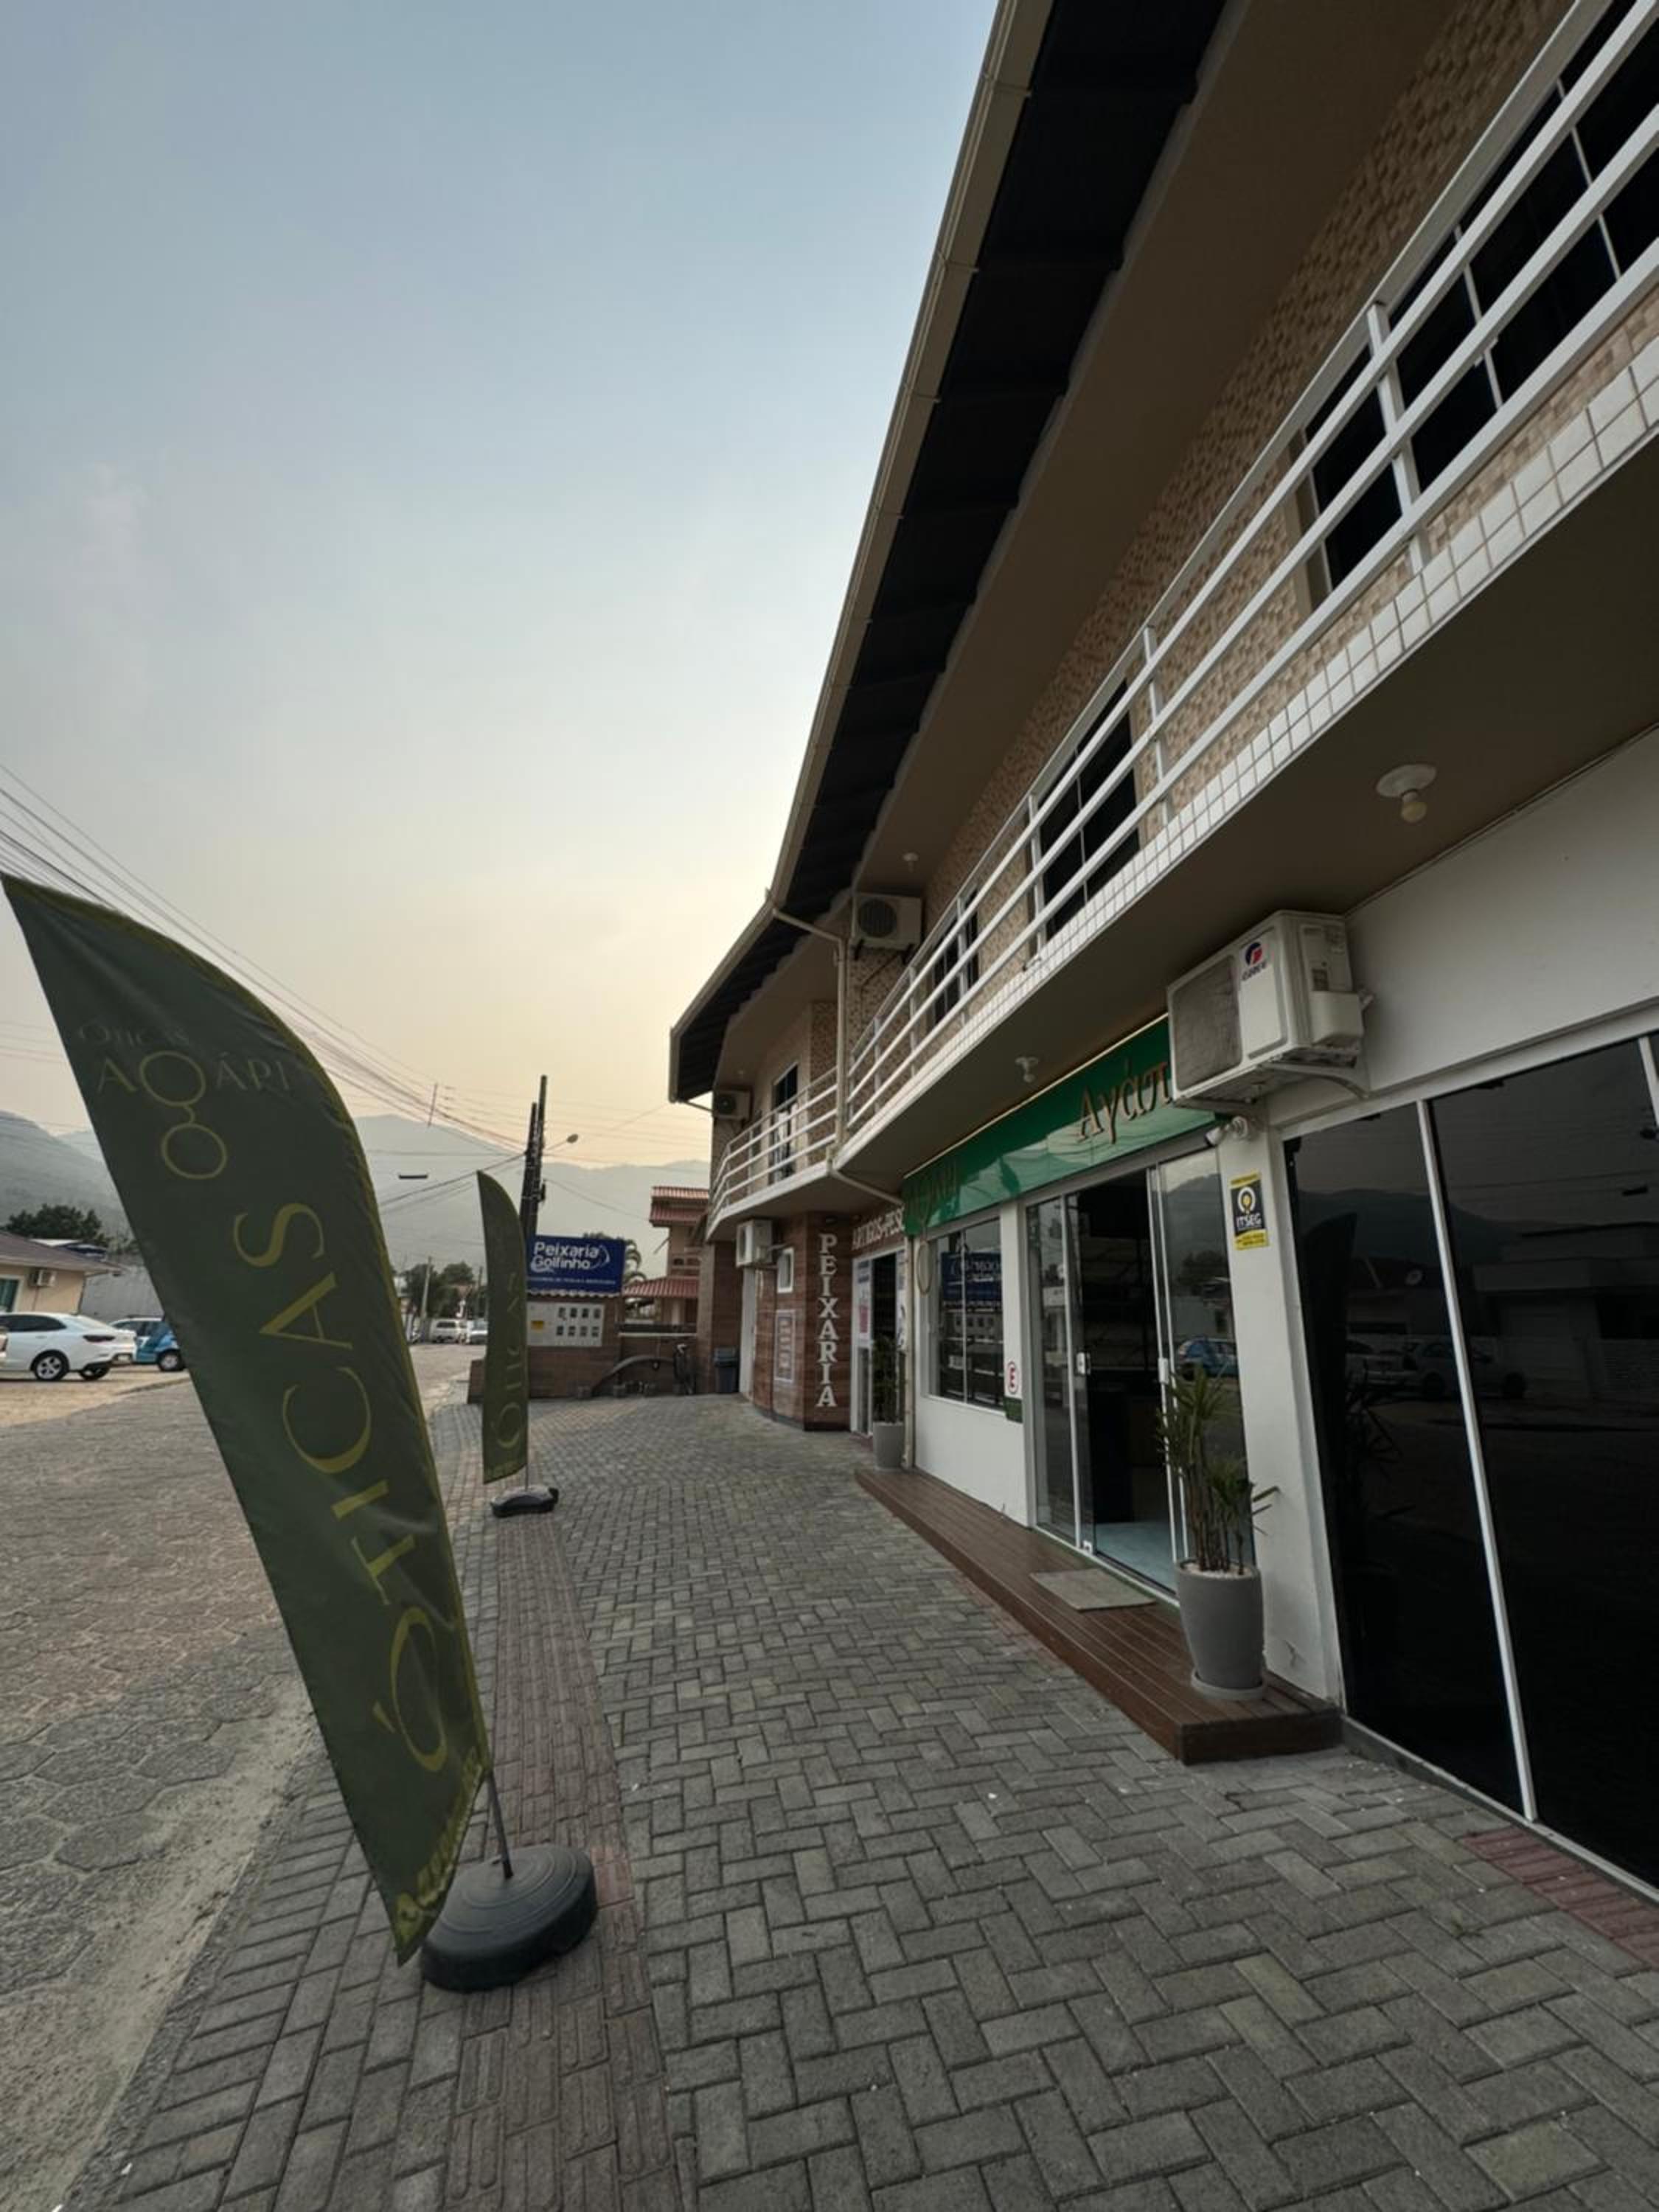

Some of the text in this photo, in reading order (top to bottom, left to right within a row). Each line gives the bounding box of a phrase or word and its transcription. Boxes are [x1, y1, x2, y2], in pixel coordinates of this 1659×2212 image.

[534, 1241, 600, 1259] Peixaria
[815, 1233, 839, 1408] PEIXARIA
[234, 1203, 446, 1771] ÓTICAS
